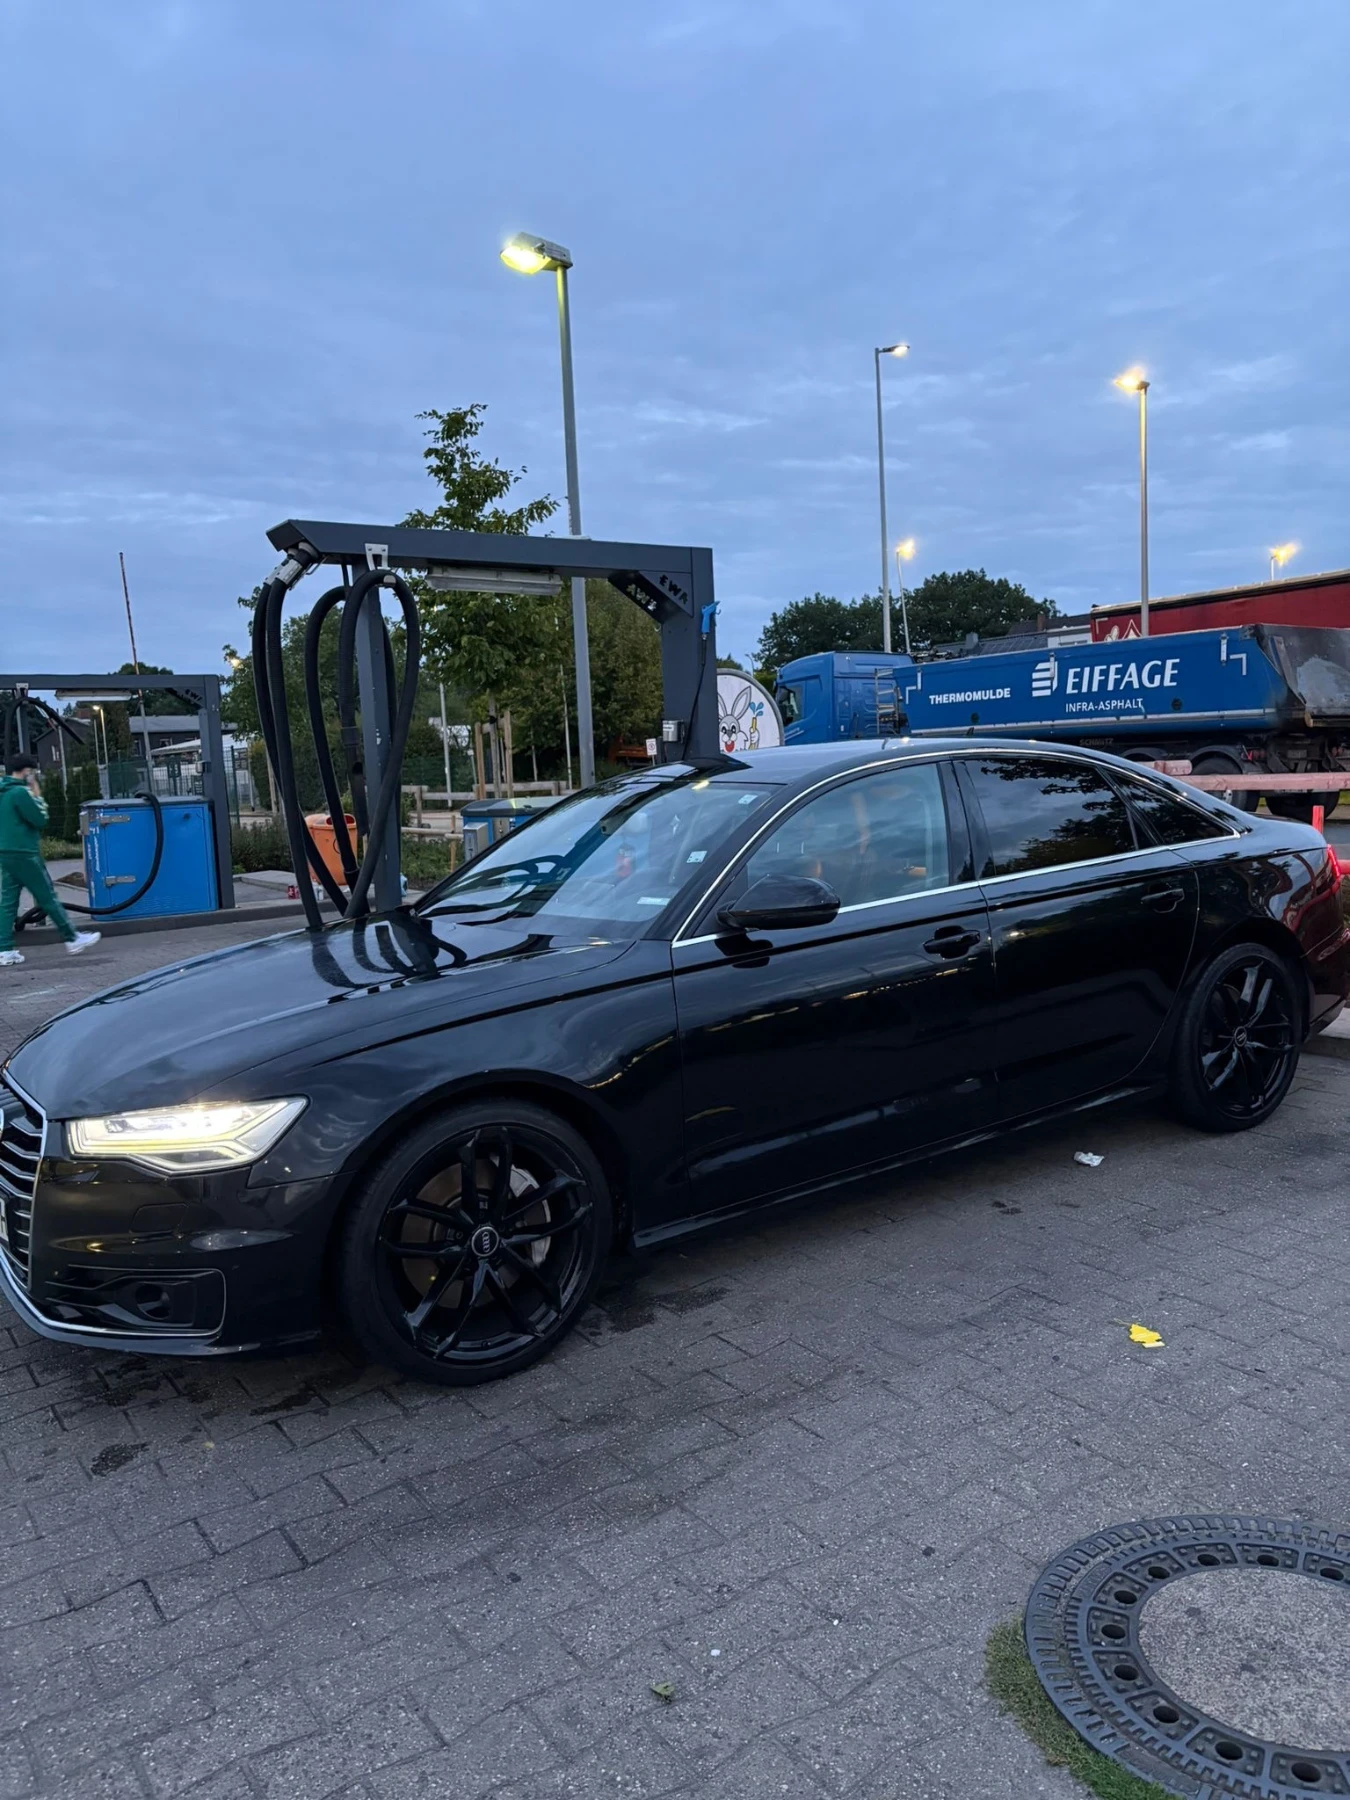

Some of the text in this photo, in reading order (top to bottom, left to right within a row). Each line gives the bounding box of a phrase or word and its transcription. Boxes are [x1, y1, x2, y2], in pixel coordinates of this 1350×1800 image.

[660, 574, 689, 605] EWA
[1065, 658, 1181, 695] EIFFAGE
[928, 687, 1012, 705] THERMOMULDE
[1065, 698, 1144, 713] INFRA-ASPHALT
